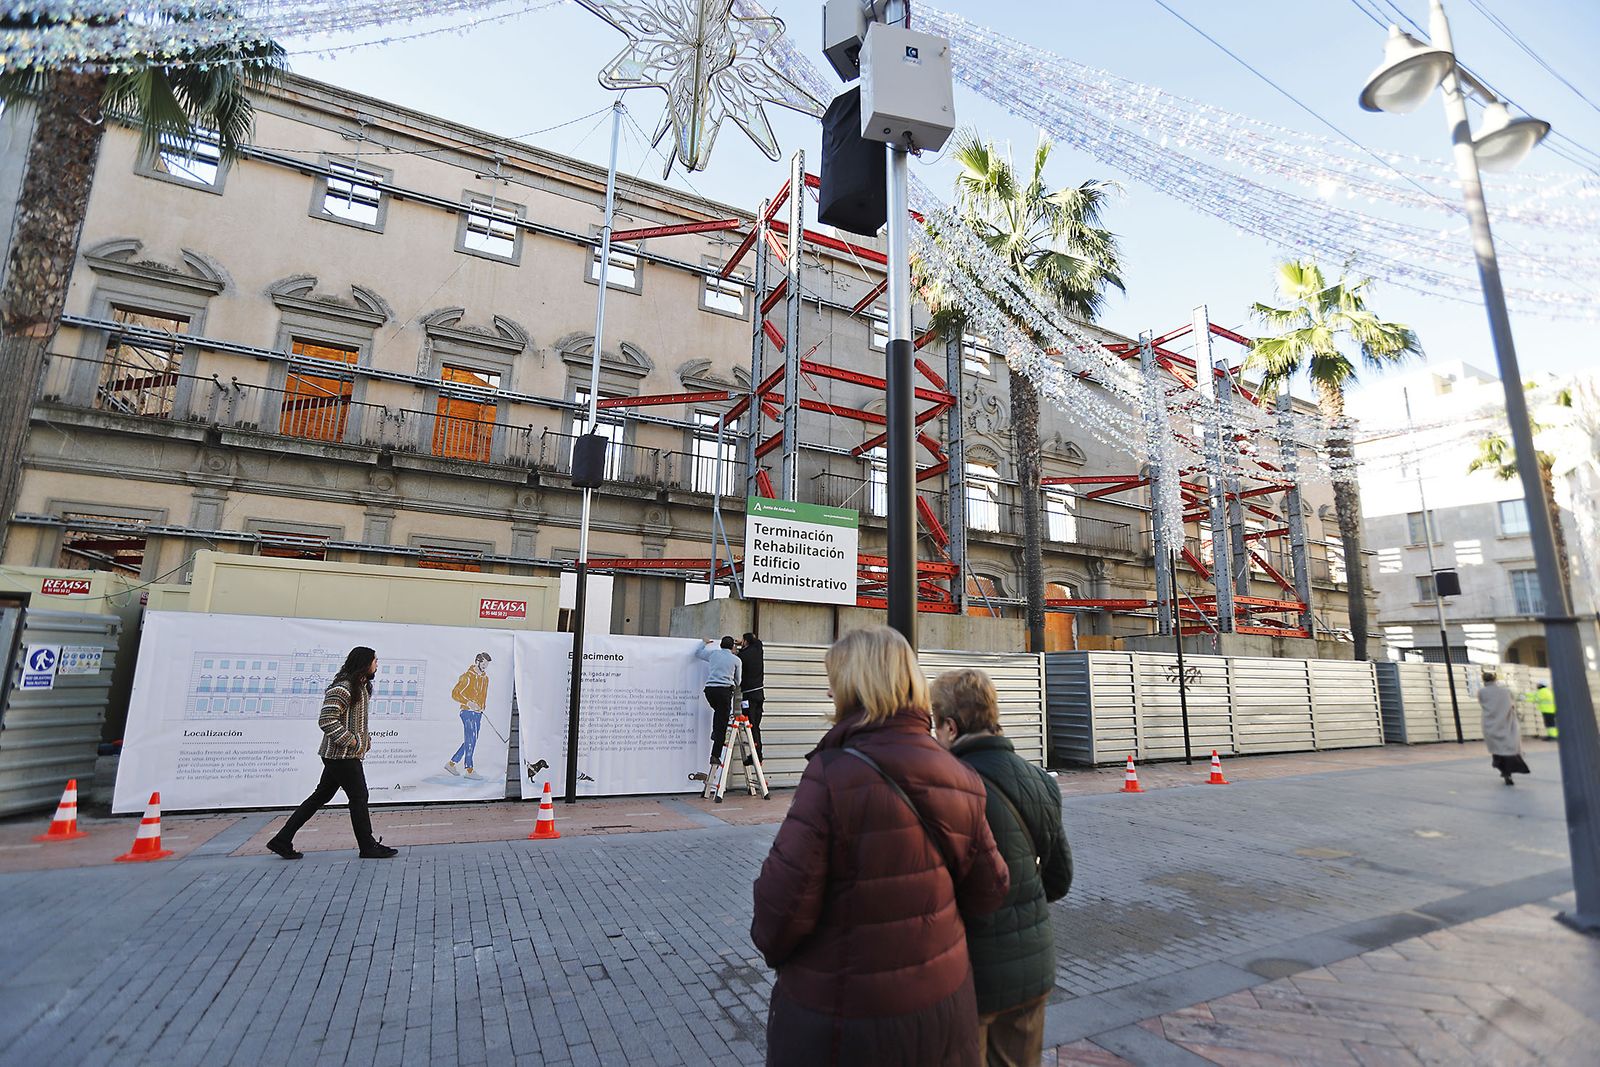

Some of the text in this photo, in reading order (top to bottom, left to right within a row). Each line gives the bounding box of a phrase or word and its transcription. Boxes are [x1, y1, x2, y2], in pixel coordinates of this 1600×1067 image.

[754, 523, 833, 542] Terminación
[754, 539, 844, 559] Rehabilitación
[753, 555, 800, 570] Edificio
[44, 580, 90, 590] REMSA
[752, 572, 847, 590] Administrativo
[481, 600, 525, 611] REMSA
